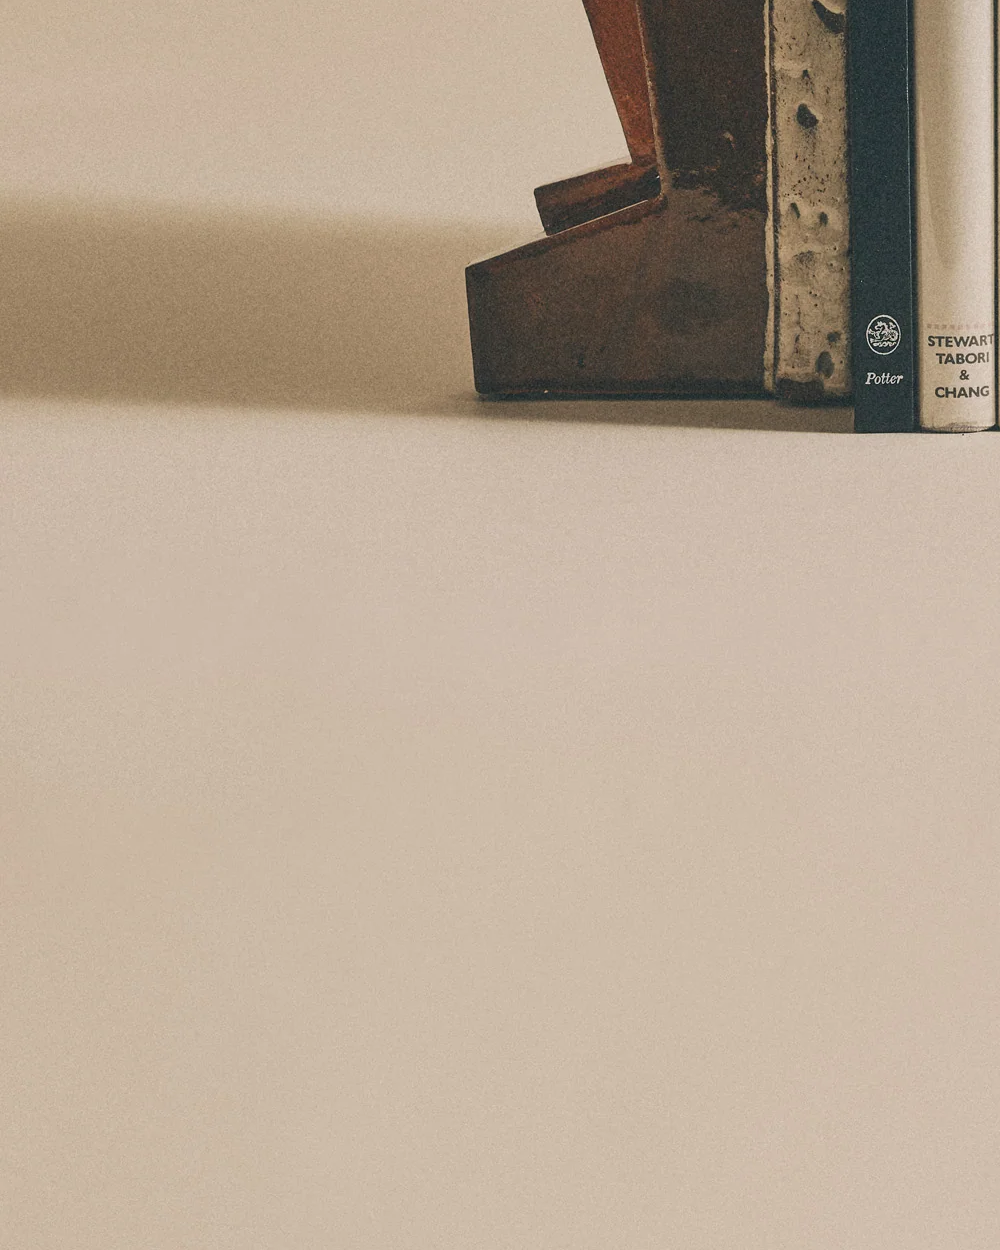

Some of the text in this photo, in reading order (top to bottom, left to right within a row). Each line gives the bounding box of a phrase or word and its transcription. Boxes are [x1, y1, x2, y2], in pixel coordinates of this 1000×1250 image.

[927, 333, 994, 348] STEWART
[935, 352, 990, 365] TABORI
[865, 372, 904, 385] Potter
[959, 369, 970, 381] &
[934, 386, 990, 399] CHANG
